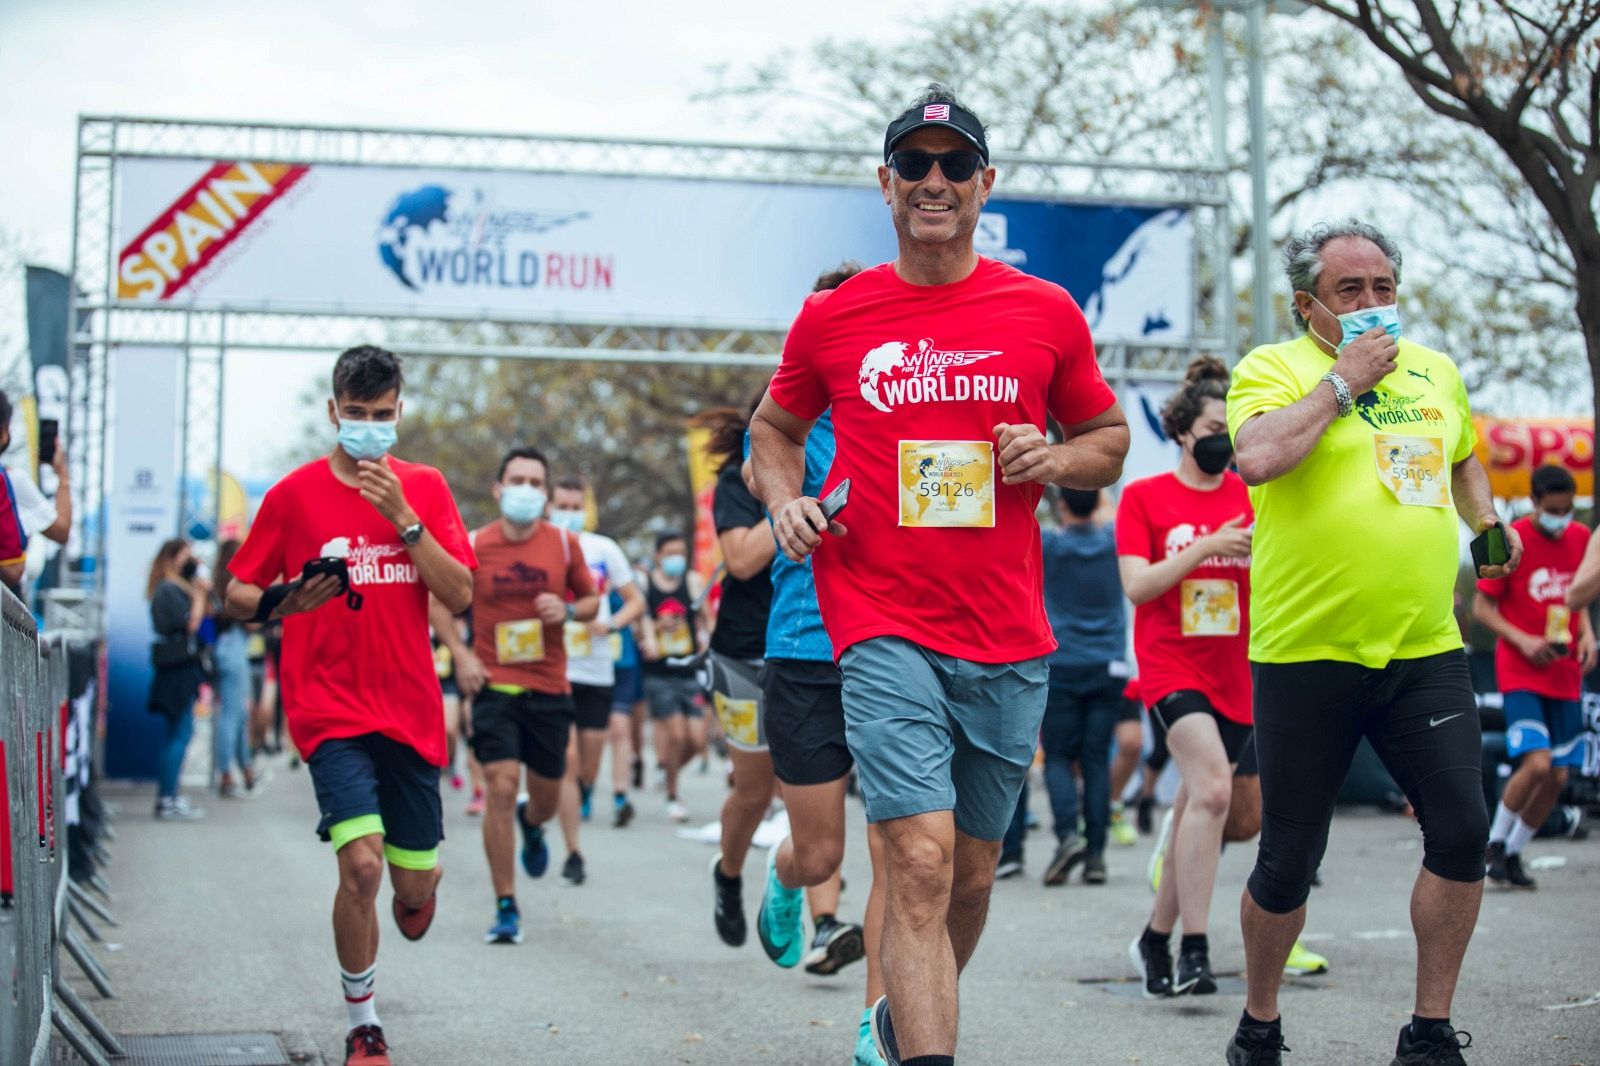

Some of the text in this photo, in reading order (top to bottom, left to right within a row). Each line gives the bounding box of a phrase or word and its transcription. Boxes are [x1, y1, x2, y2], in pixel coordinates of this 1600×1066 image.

[121, 161, 274, 299] SPAIN
[418, 250, 614, 288] WORLD RUN
[904, 351, 966, 367] WINGS
[901, 365, 948, 378] FOR LIFE
[883, 375, 1019, 407] WORLD RUN
[1374, 408, 1445, 425] WORLD RUN
[1392, 467, 1433, 482] 59105
[920, 482, 974, 497] 59126
[348, 563, 395, 586] ORLD
